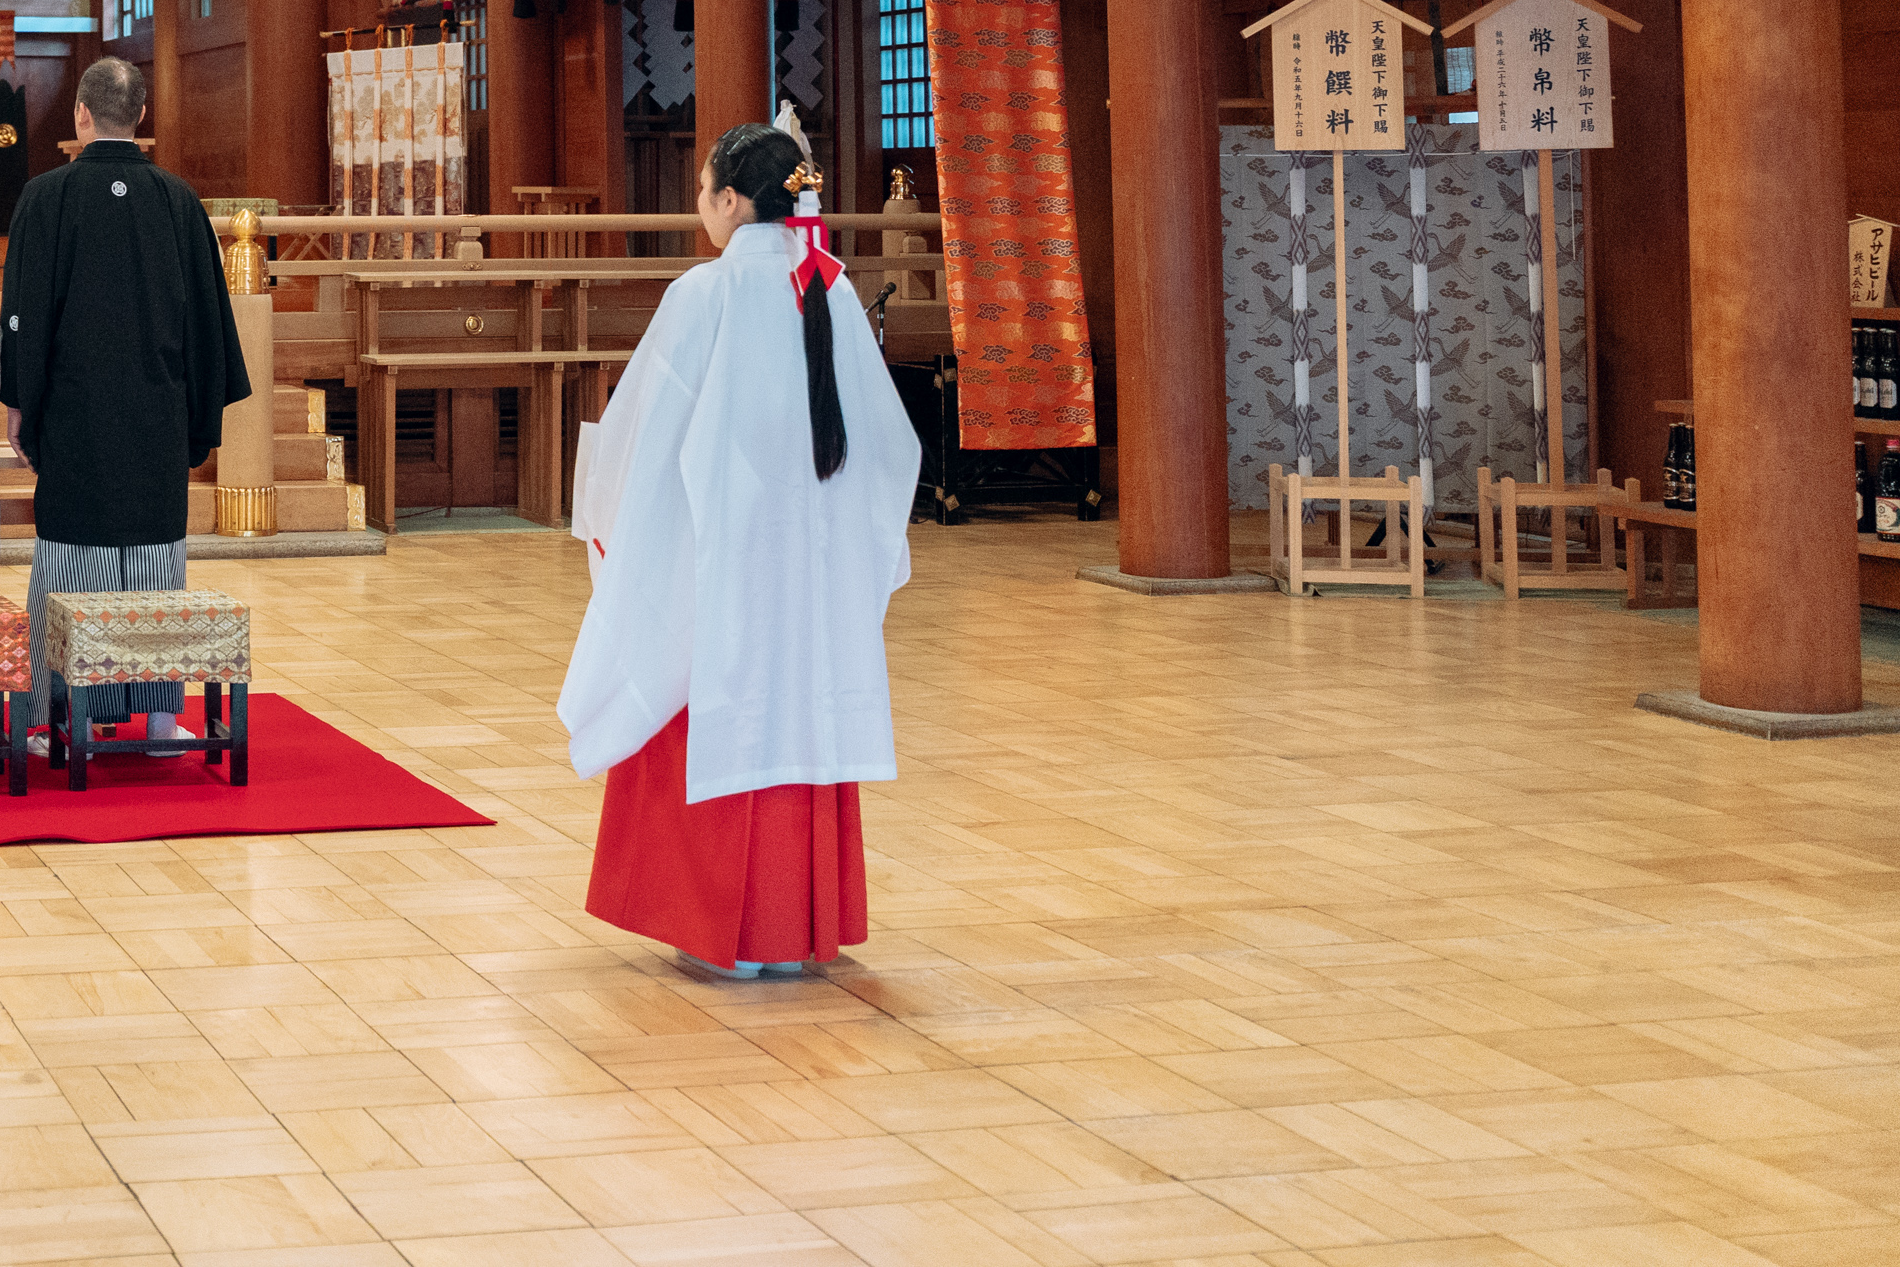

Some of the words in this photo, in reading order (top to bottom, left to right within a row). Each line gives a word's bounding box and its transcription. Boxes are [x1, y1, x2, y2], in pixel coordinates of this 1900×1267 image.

[1293, 56, 1304, 137] 令和五年九月十六日
[1325, 29, 1354, 135] 幣饌料
[1371, 20, 1389, 134] 天皇陛下御下賜
[1529, 27, 1559, 135] 幣帛料
[1575, 17, 1595, 133] 天皇陛下御下賜
[1851, 250, 1865, 303] 株式会社
[1866, 227, 1884, 302] アサヒビール
